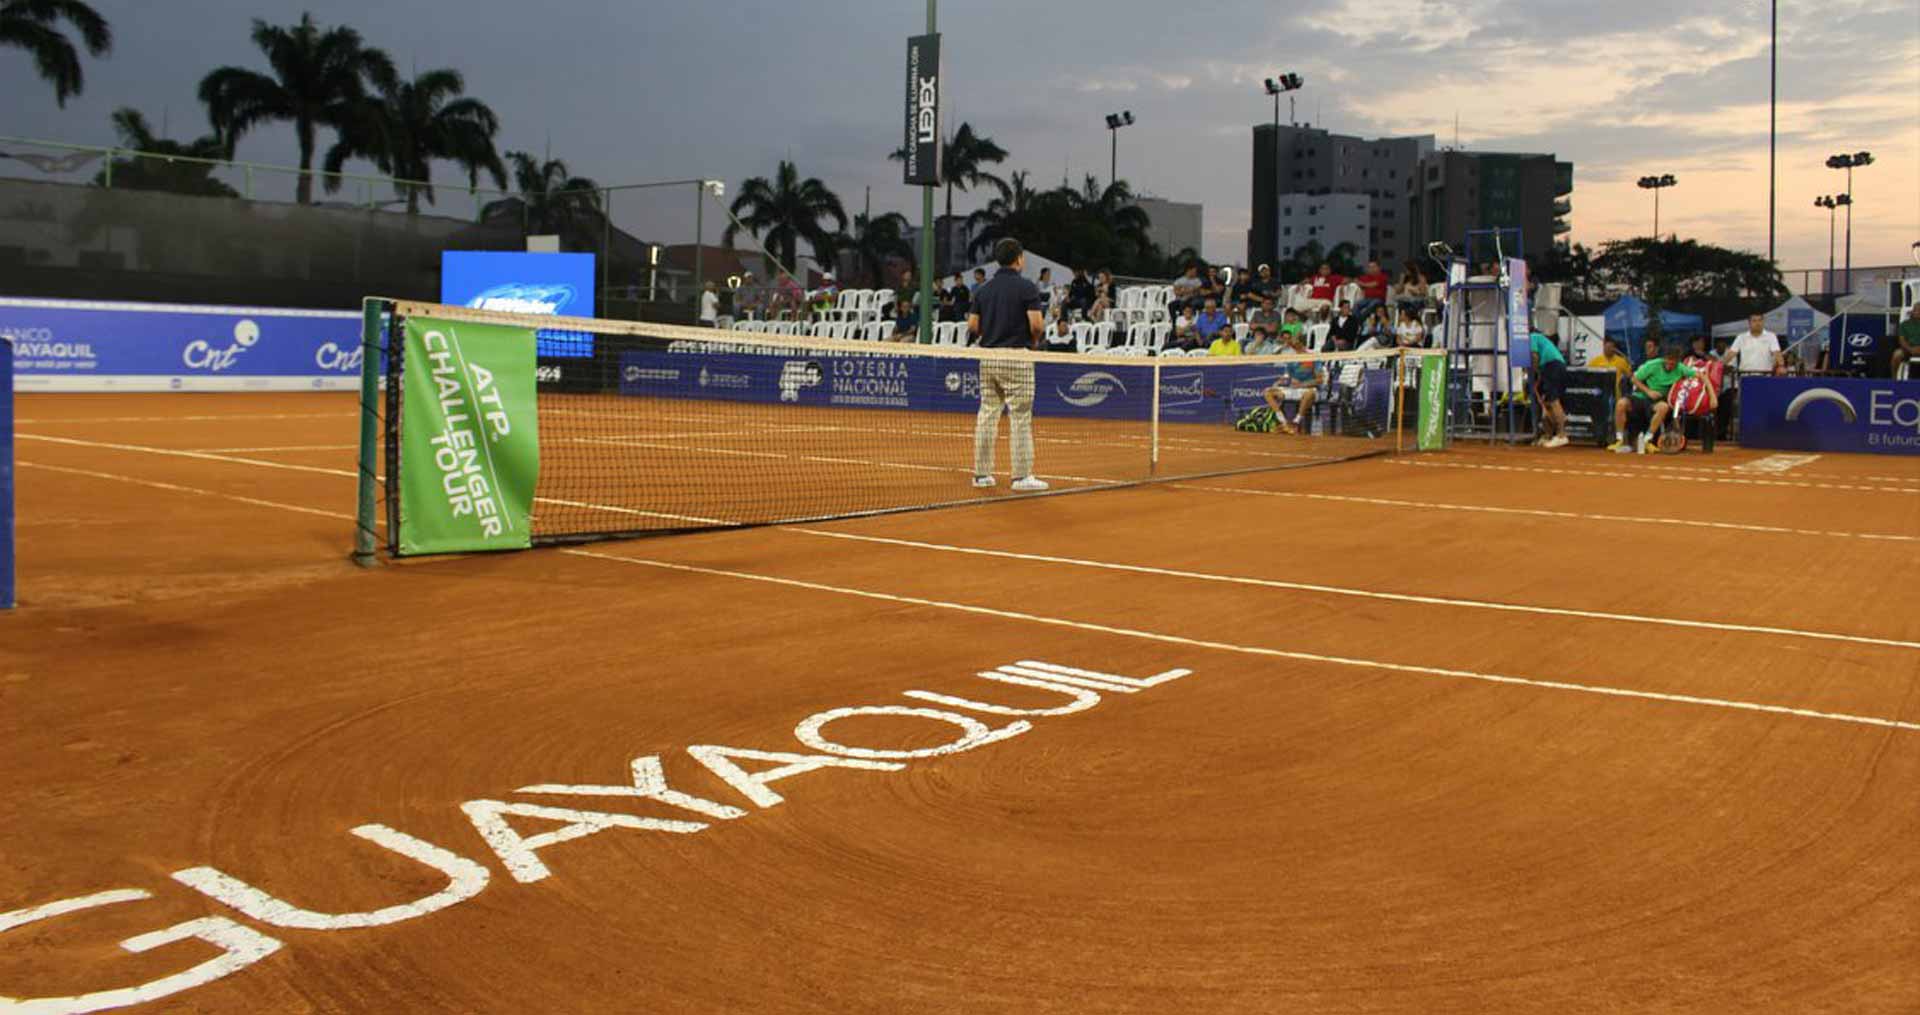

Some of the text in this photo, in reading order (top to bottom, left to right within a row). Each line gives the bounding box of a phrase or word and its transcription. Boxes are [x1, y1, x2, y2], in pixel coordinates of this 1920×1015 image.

[910, 116, 918, 153] CANCHA
[919, 76, 936, 143] LEDEX
[909, 154, 917, 176] ESTA
[0, 327, 52, 341] ANCO
[183, 339, 246, 371] Cnt
[833, 360, 909, 378] LOTERIA
[469, 362, 510, 436] ATP
[424, 331, 502, 539] CHALLENGER
[431, 428, 473, 518] TOUR
[0, 660, 1193, 1015] GUAYAQUIL
